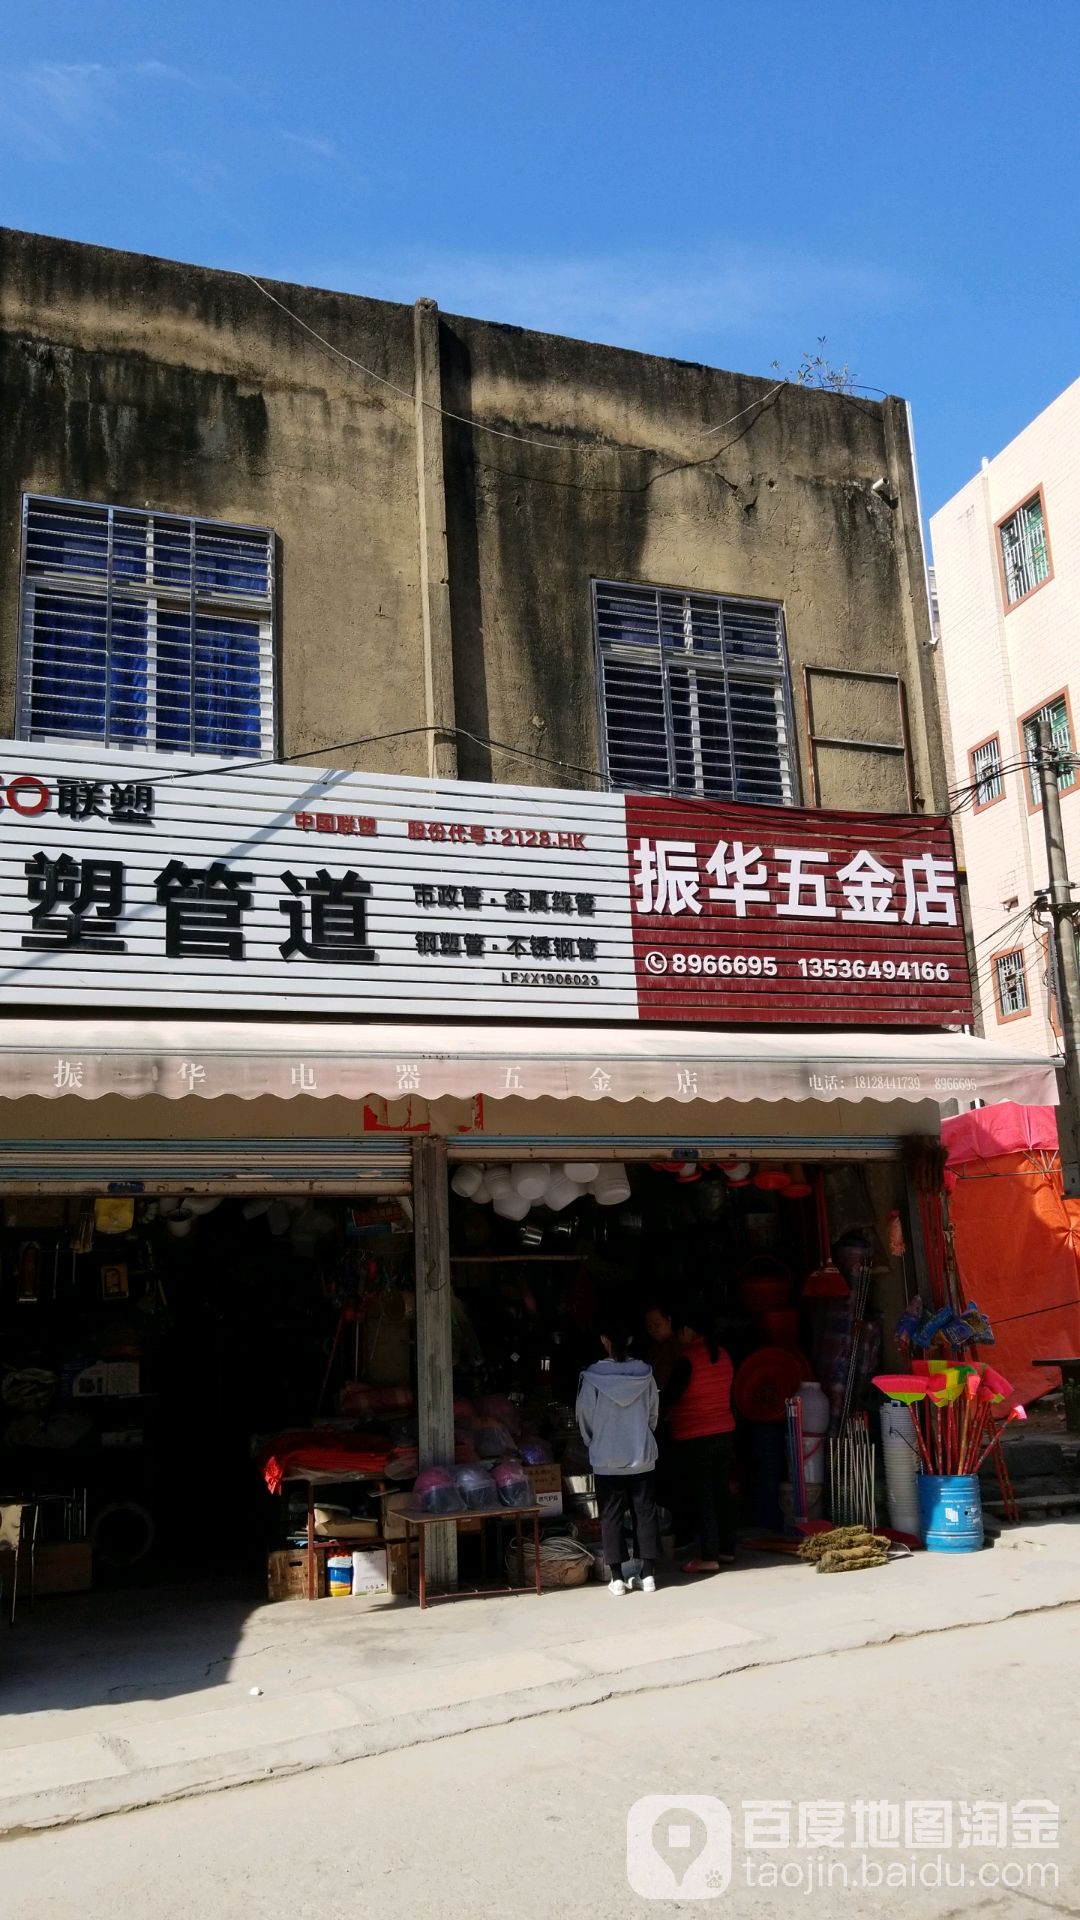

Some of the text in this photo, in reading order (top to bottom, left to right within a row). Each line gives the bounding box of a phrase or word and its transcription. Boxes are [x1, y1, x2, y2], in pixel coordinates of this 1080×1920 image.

[57, 779, 155, 825] 联塑
[295, 811, 377, 836] 中国联塑
[633, 838, 957, 926] 振华五金店
[22, 851, 375, 962] 塑管道
[672, 953, 949, 981] 8966695 13536494166
